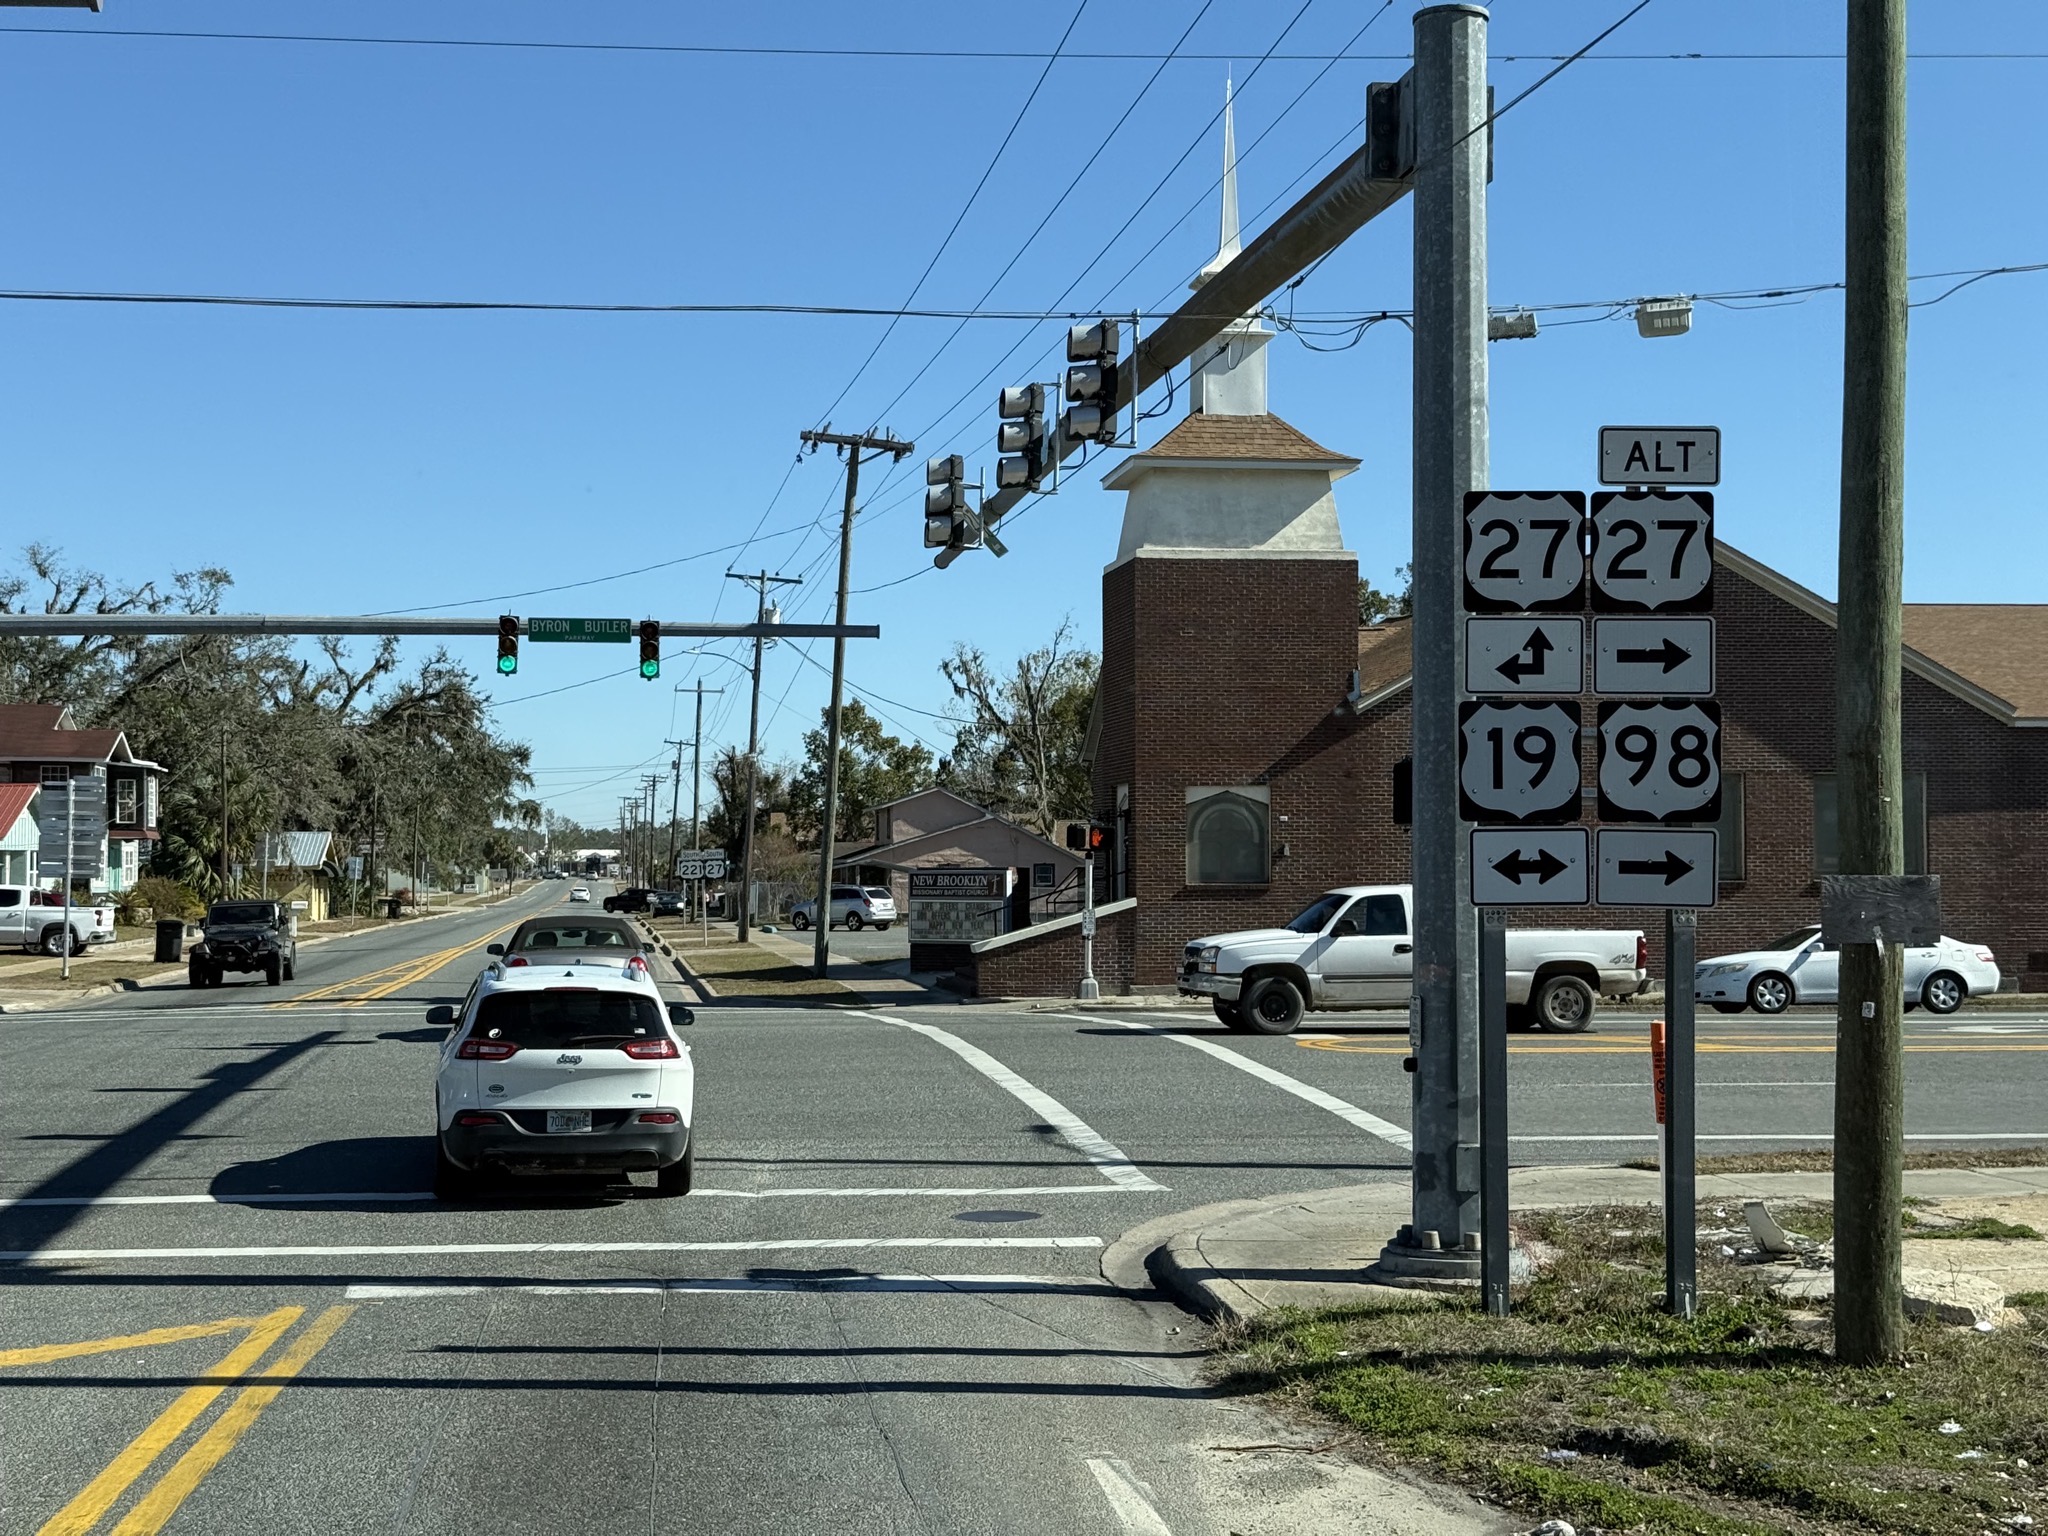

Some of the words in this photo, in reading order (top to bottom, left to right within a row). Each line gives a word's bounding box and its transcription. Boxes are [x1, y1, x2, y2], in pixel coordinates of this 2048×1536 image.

[1624, 440, 1696, 473] ALT
[1478, 518, 1571, 580] 27
[1605, 518, 1699, 580] 27
[531, 619, 570, 632] BYRON
[584, 620, 628, 633] BUTLER
[1486, 725, 1557, 790] 19
[1614, 724, 1712, 789] 98
[706, 850, 723, 858] SOUTH
[682, 865, 702, 876] 221
[707, 864, 723, 875] 27
[912, 875, 936, 886] NEW
[936, 875, 989, 886] BROOKLYN
[556, 1053, 583, 1066] Jeep
